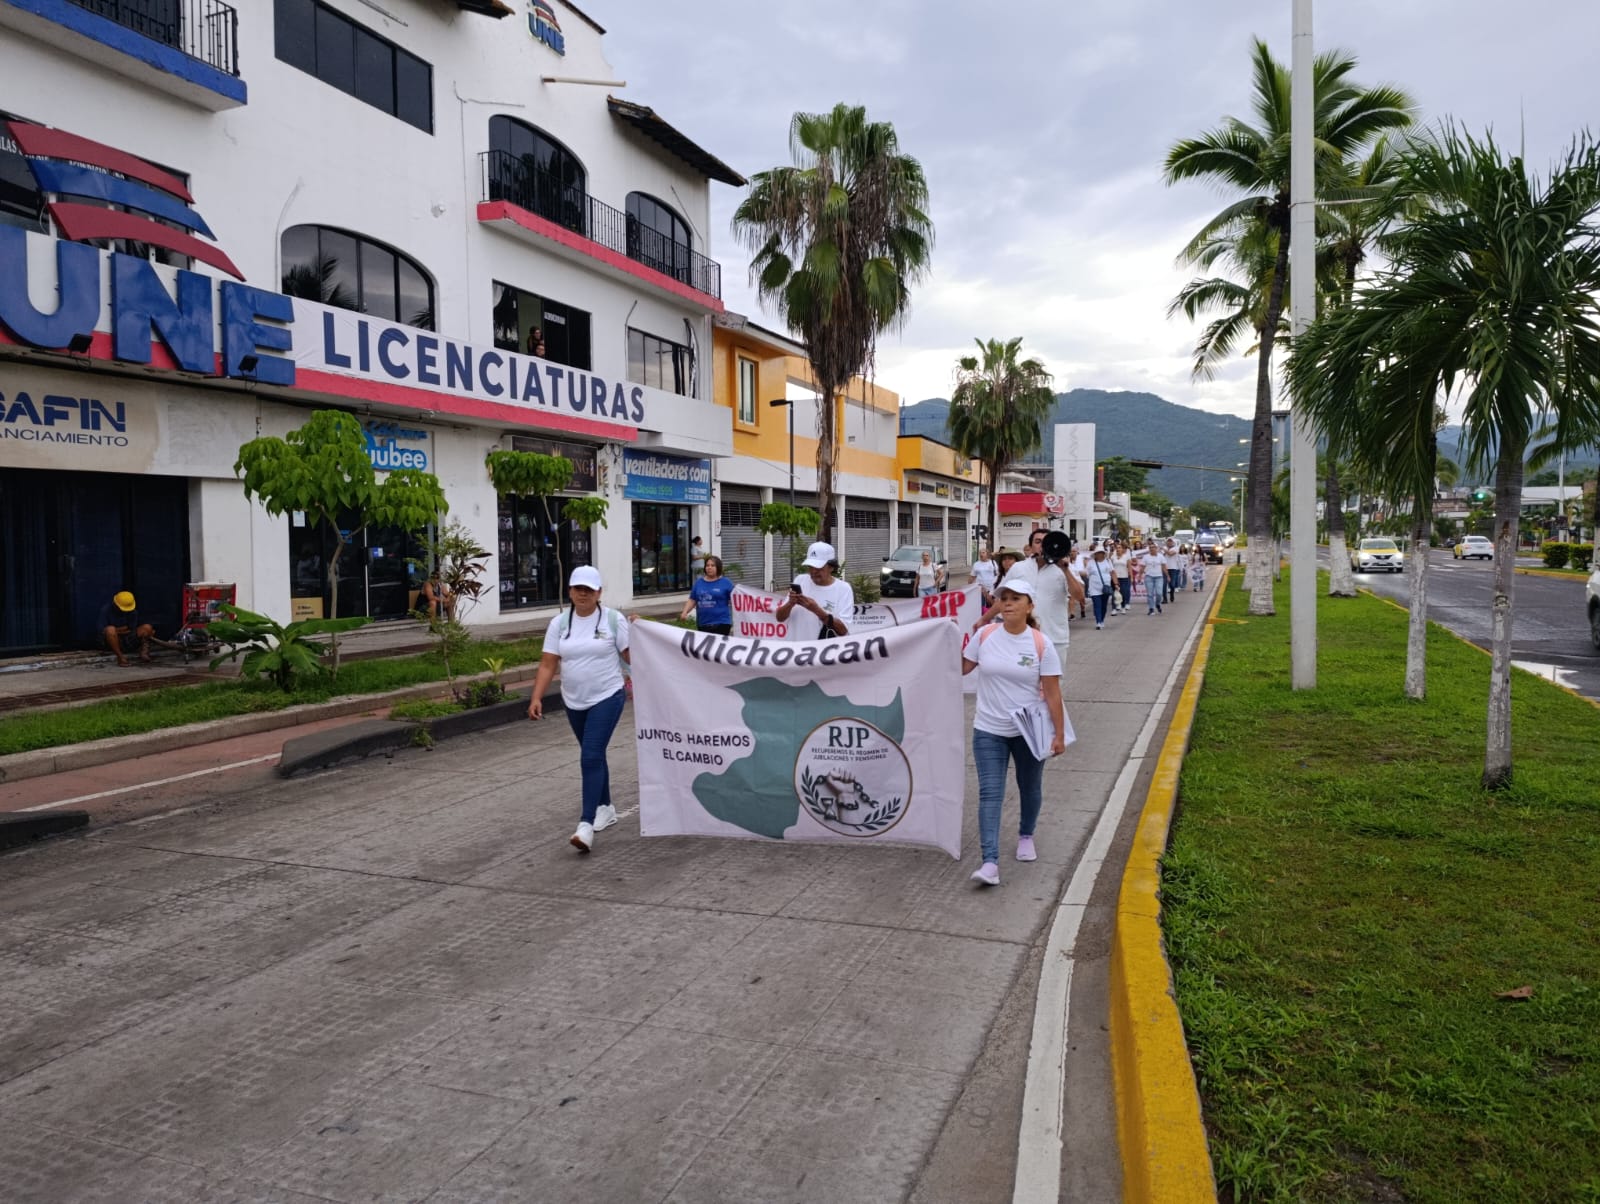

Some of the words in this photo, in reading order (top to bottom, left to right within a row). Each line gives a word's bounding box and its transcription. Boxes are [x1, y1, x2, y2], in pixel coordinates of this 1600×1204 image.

[528, 11, 565, 56] UNE
[0, 222, 295, 386] UNE
[322, 311, 645, 423] LICENCIATURAS
[0, 391, 126, 432] AFIN
[0, 428, 129, 447] NCIAMIENTO
[733, 594, 773, 613] UMAE
[681, 630, 890, 667] Michoacan
[638, 729, 682, 743] JUNTOS
[687, 733, 750, 747] HAREMOS
[828, 726, 870, 748] RJP
